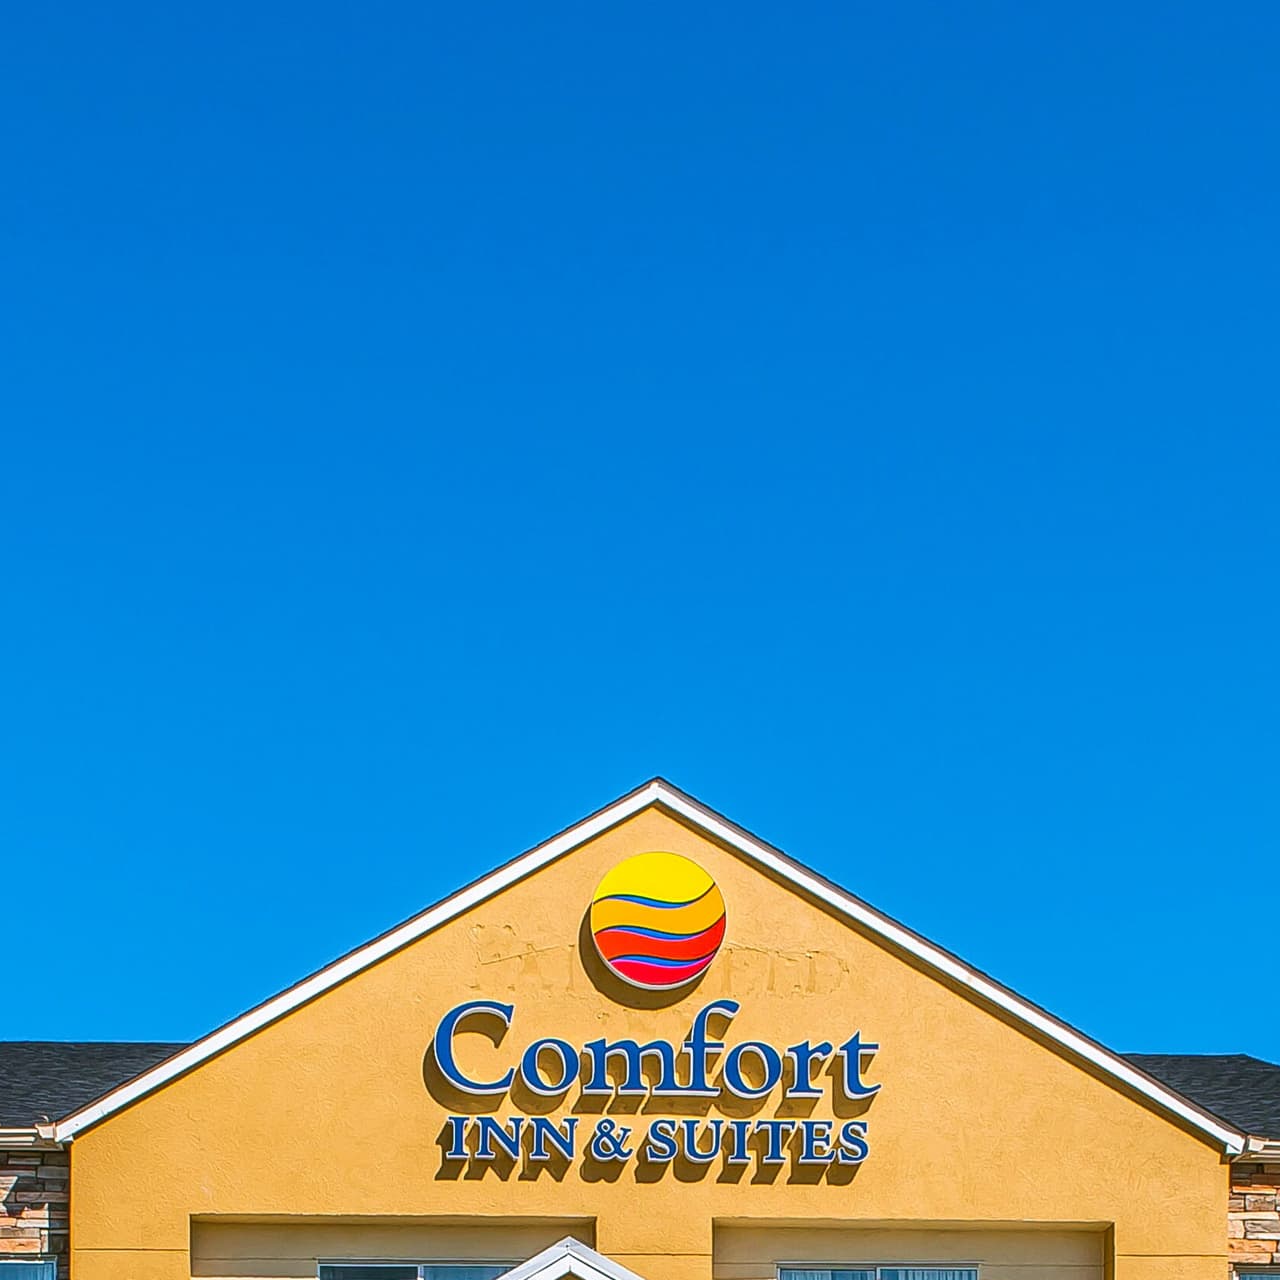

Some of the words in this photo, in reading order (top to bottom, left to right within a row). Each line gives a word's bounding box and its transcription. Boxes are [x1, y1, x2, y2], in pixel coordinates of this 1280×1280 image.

[433, 1000, 882, 1100] Comfort
[446, 1115, 578, 1161] INN
[591, 1118, 634, 1162] &
[645, 1119, 869, 1165] SUITES
